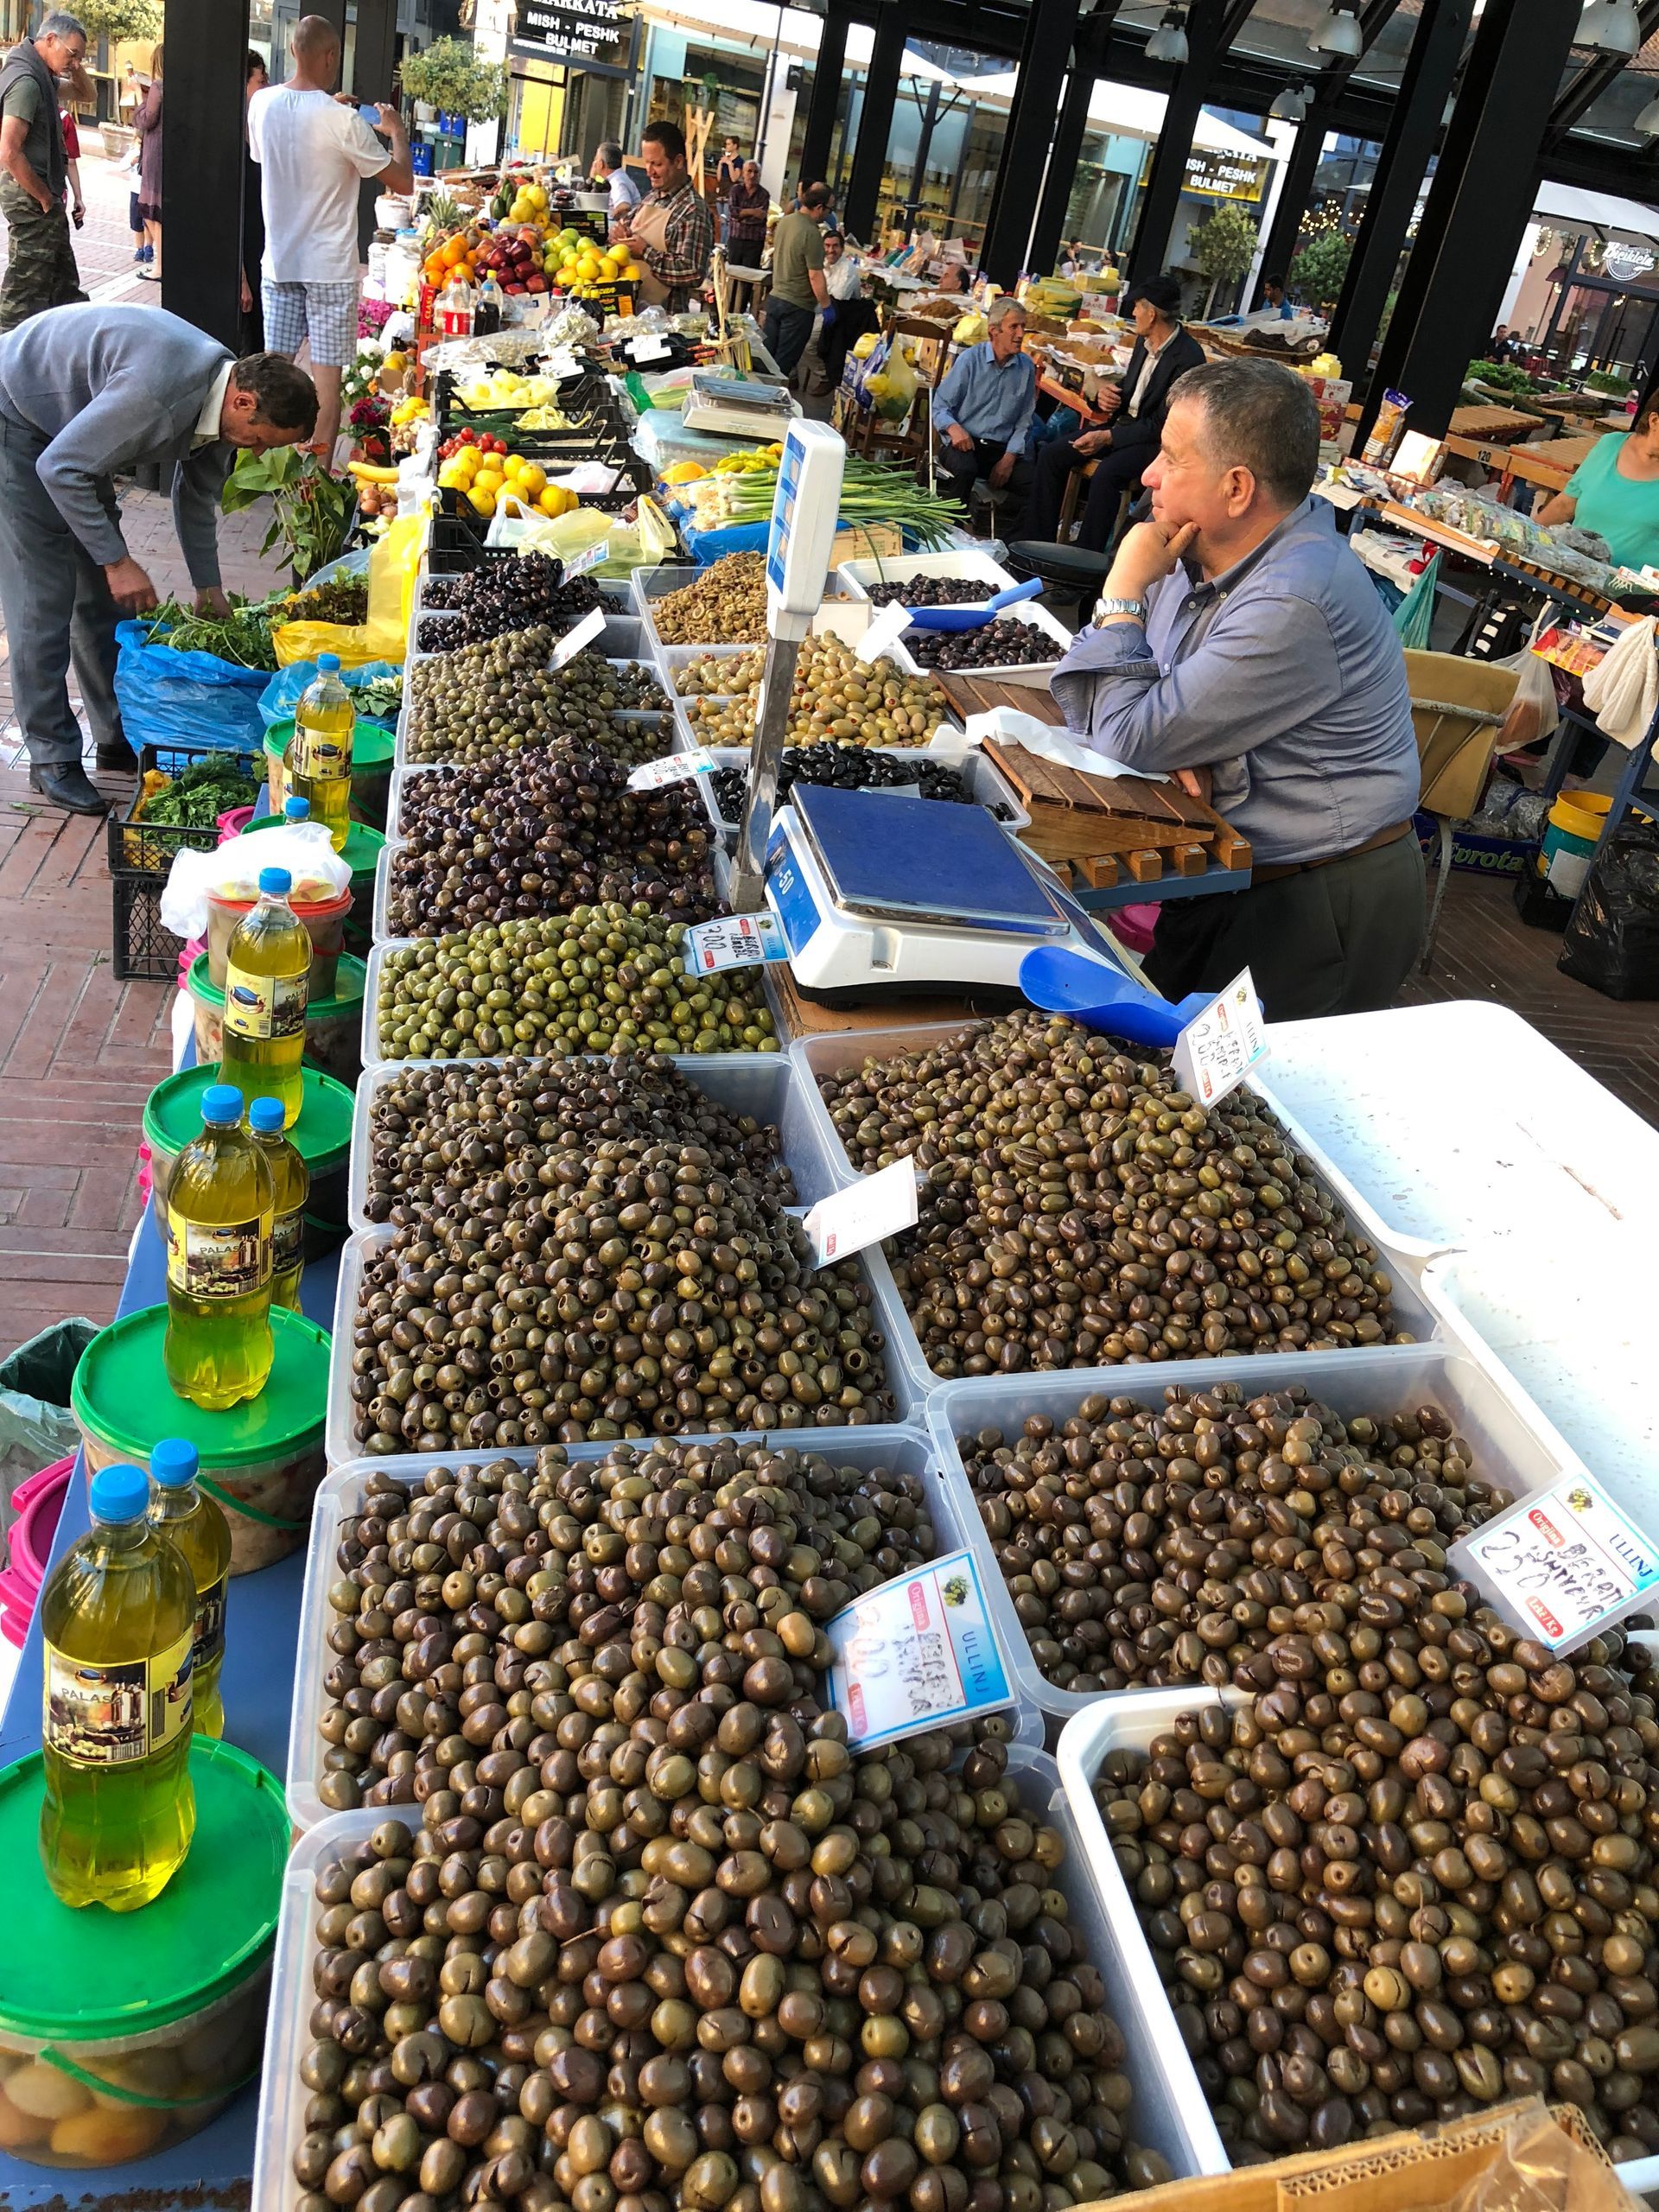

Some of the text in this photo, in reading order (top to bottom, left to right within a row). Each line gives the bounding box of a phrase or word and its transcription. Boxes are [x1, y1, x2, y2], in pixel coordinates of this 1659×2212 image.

[532, 0, 619, 19] RKATA
[527, 11, 561, 30] MISH
[575, 22, 620, 43] PESHK
[546, 32, 599, 54] BULMET
[1185, 158, 1206, 173] ISH
[1217, 165, 1257, 183] PESHK
[1190, 175, 1236, 194] BULMET
[424, 295, 433, 320] CLASS
[1478, 449, 1491, 462] 120
[1532, 1512, 1563, 1546] Origjina
[1481, 1530, 1551, 1588] 250
[1609, 1533, 1654, 1578] ULLINJ
[910, 1586, 927, 1627] Origjina
[963, 1630, 988, 1694] ULLINJ
